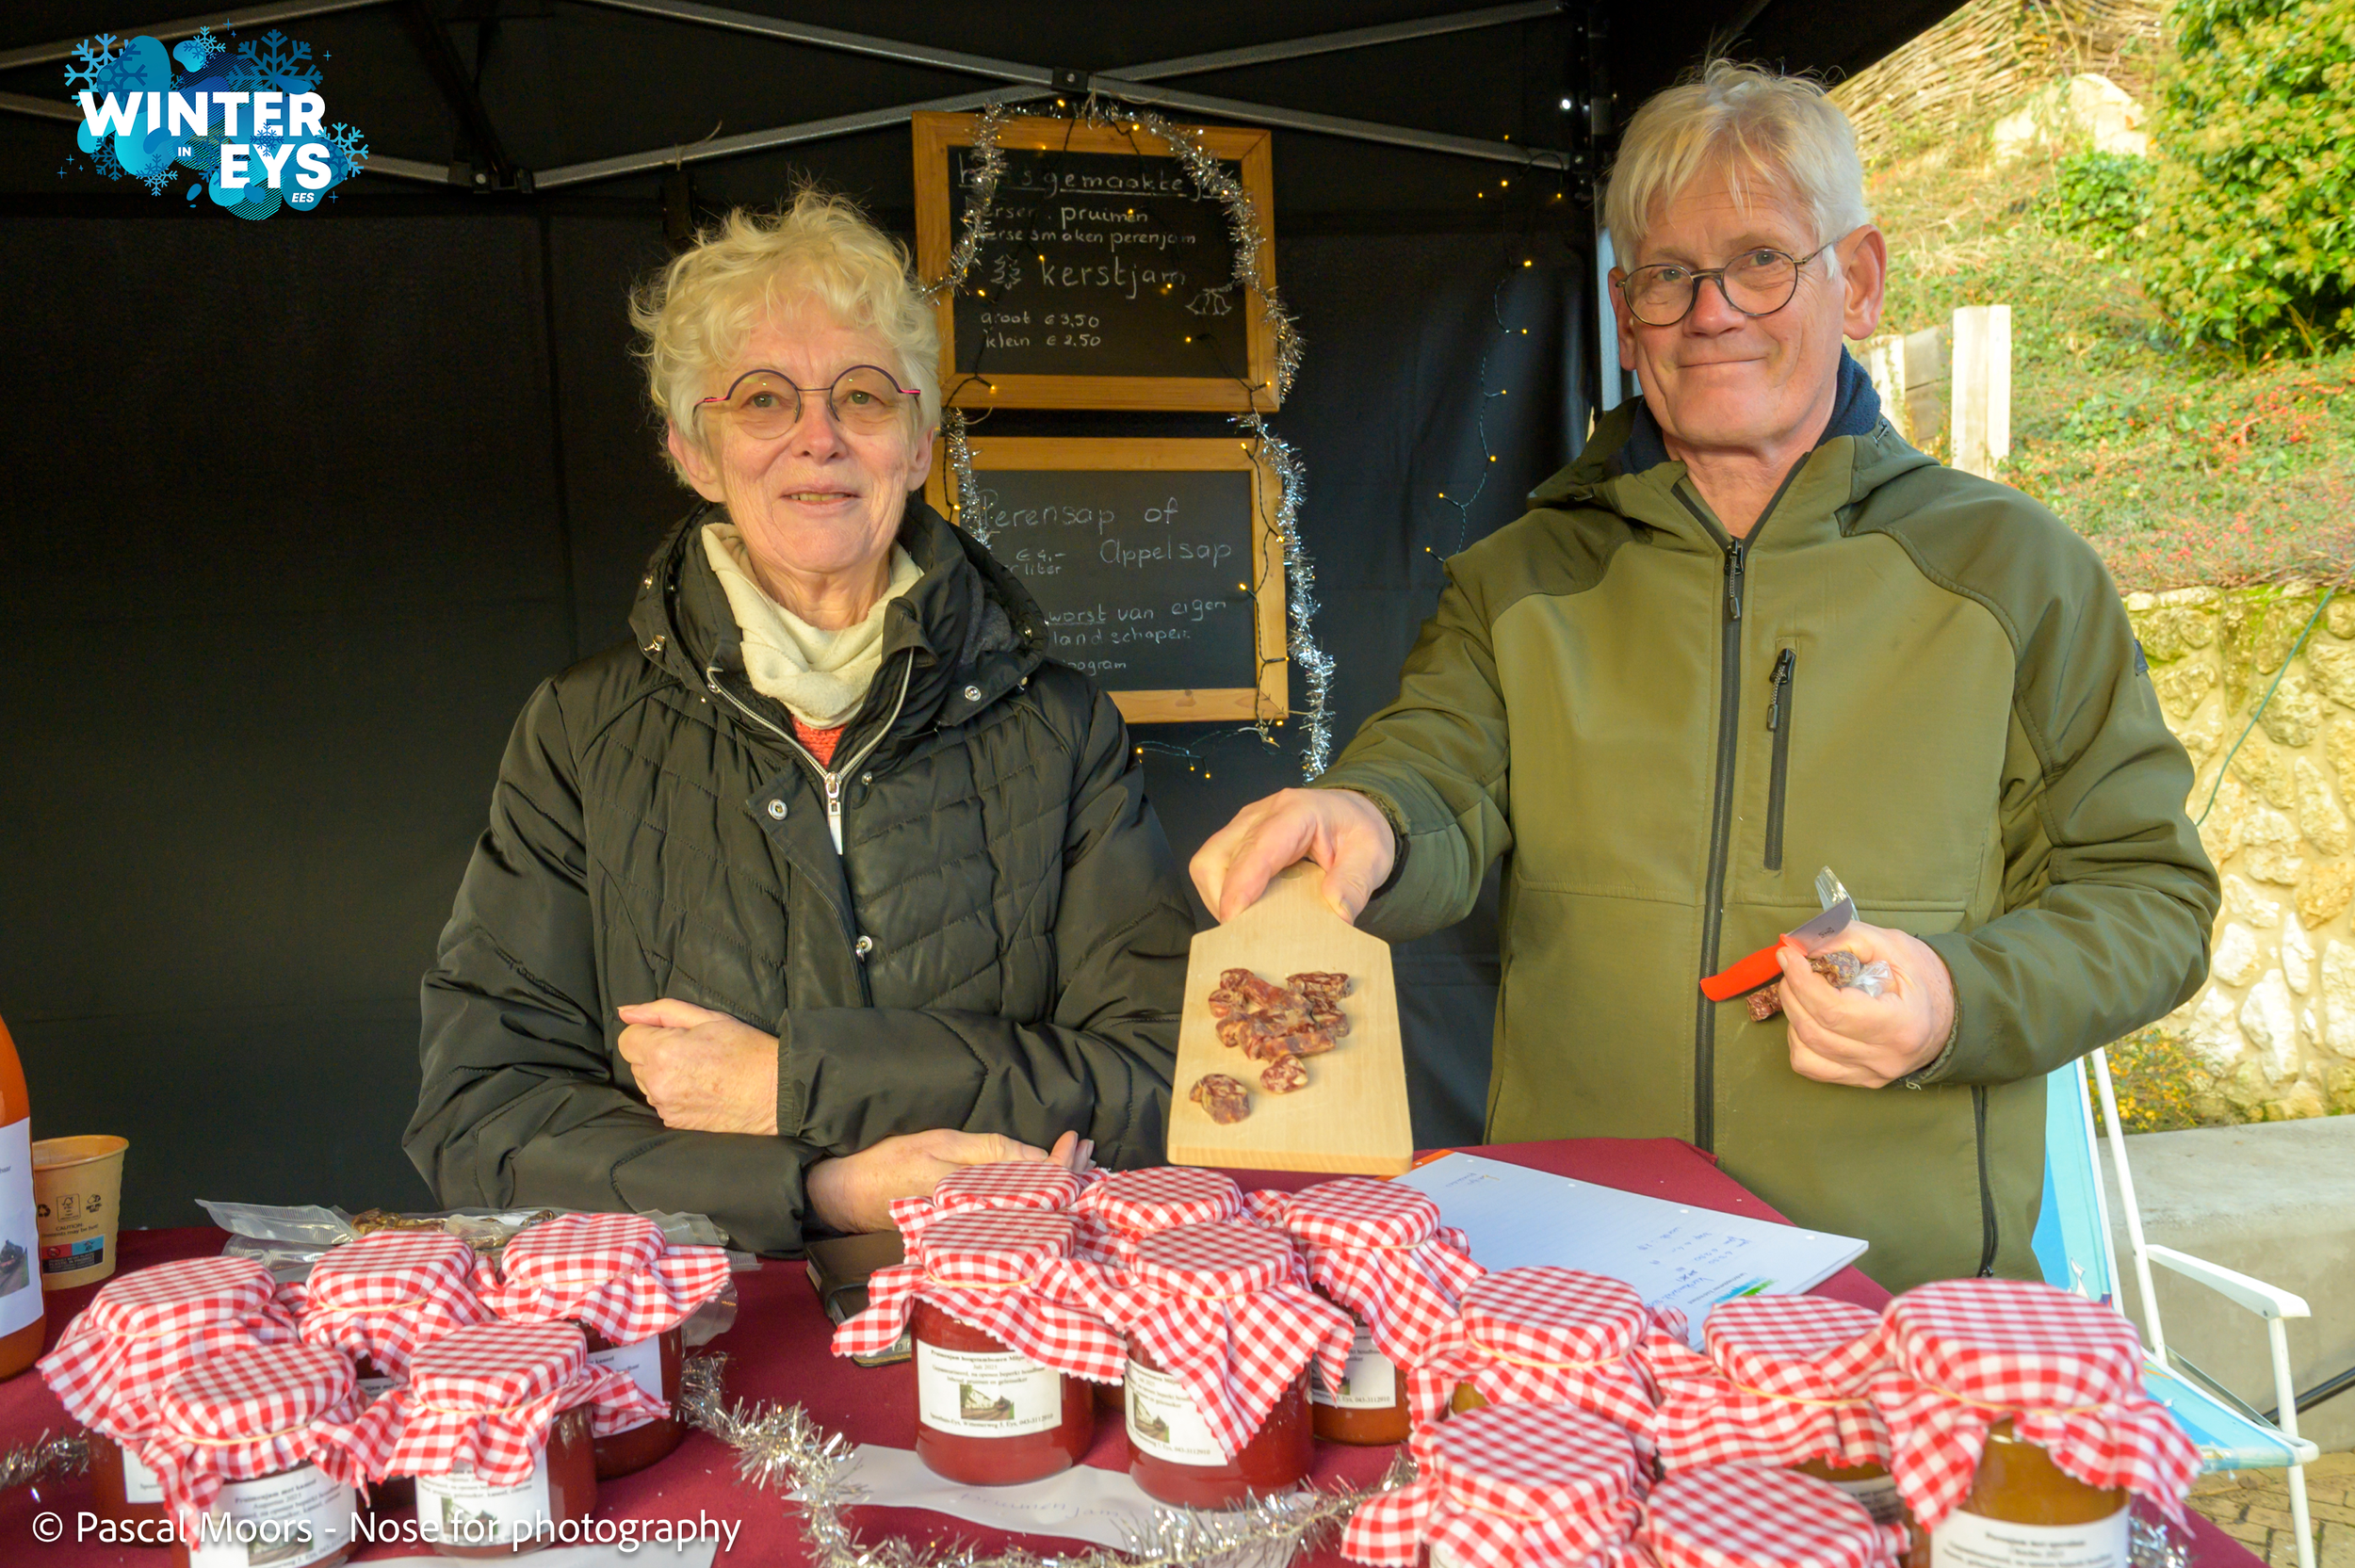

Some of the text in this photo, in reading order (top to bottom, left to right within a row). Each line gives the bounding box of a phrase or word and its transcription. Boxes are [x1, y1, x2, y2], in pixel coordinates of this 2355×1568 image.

[1061, 206, 1148, 231] pruimen
[1031, 229, 1103, 242] smaken
[1041, 255, 1186, 299] kerstjam
[1061, 314, 1100, 328] 3,50
[985, 332, 1031, 348] klein
[977, 489, 1178, 535] Perensap of
[1025, 562, 1063, 575] liter
[1048, 599, 1227, 623] worst van eigen
